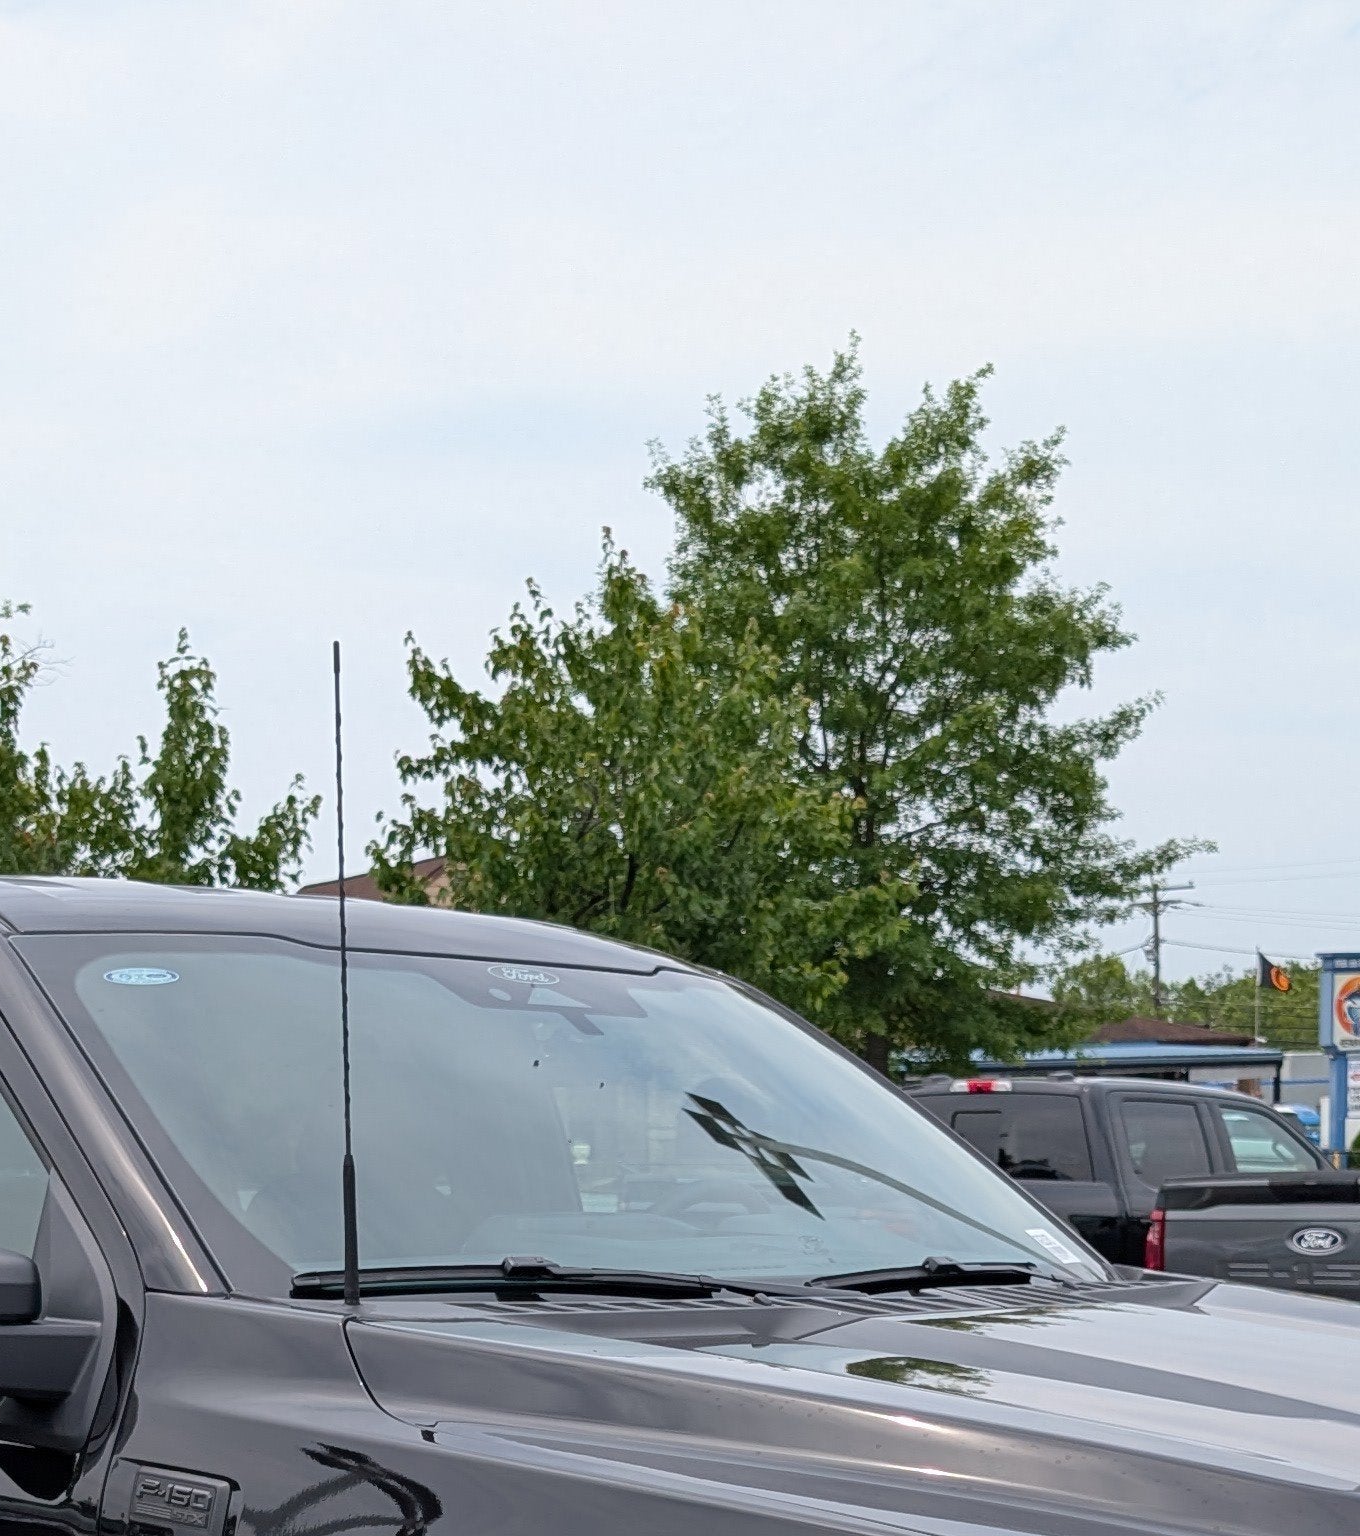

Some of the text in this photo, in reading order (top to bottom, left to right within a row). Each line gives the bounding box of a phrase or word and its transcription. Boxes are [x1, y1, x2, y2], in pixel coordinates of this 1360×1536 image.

[500, 964, 551, 983] Ford
[1299, 1231, 1335, 1249] Ford
[136, 1478, 213, 1512] F-150
